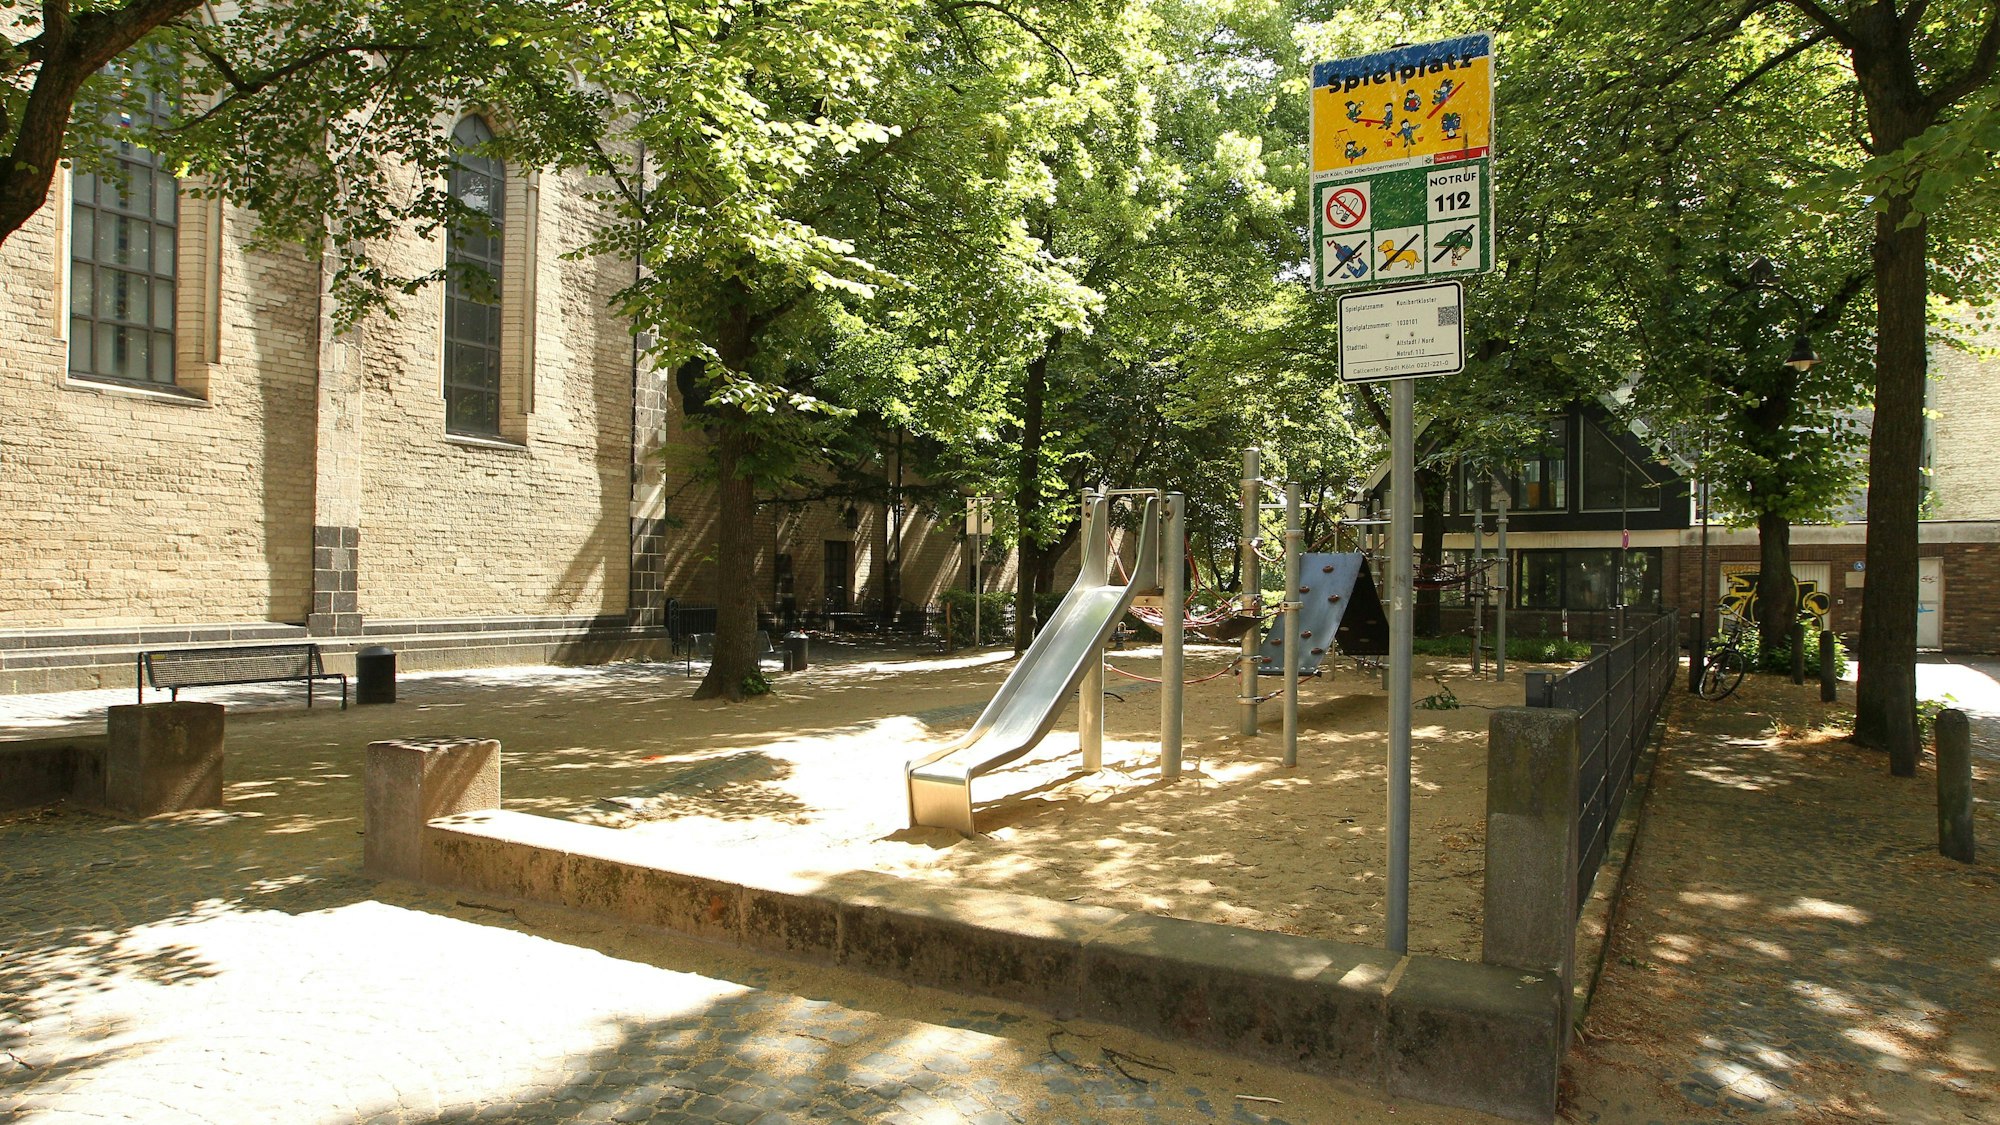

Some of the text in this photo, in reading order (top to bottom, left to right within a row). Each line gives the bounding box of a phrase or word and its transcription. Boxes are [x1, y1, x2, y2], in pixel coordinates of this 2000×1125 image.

[1328, 53, 1473, 94] Spielplatz
[1354, 161, 1410, 174] Oberbürgermeisterin
[1430, 172, 1477, 187] NOTRUF
[1435, 191, 1471, 213] 112
[1353, 366, 1382, 374] Callcenter
[1416, 359, 1449, 369] 0221-221-0
